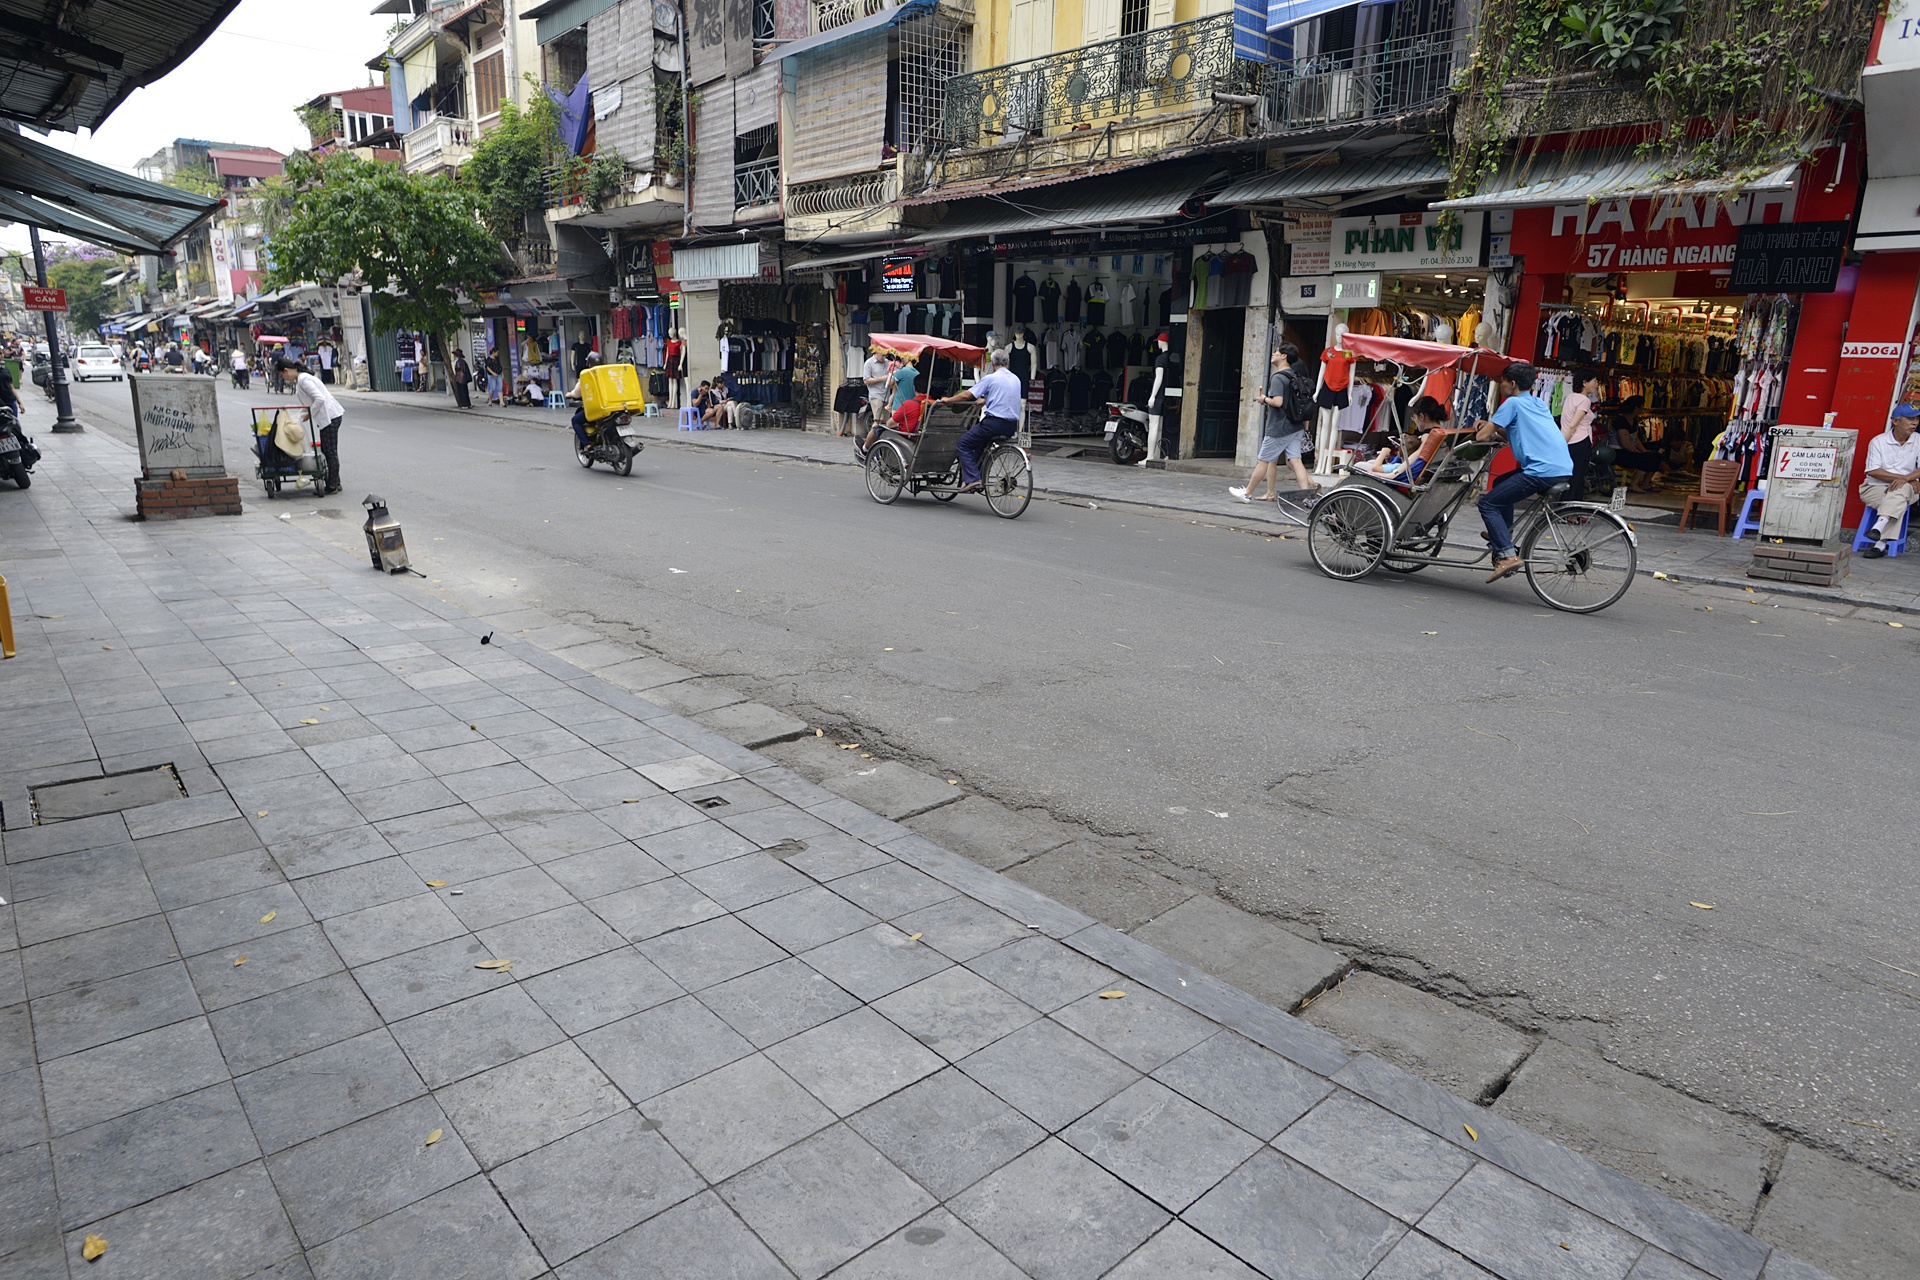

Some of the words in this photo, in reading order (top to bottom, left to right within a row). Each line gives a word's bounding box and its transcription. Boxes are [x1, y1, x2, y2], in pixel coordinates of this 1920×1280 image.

[1344, 226, 1416, 254] PHAN
[1766, 232, 1800, 248] TRANG
[1822, 230, 1840, 247] EM
[1458, 256, 1473, 264] 2330
[1587, 244, 1616, 268] 57
[1619, 247, 1668, 266] HÀNG
[1673, 244, 1736, 264] NGANG
[1342, 259, 1356, 269] Hàng
[1358, 260, 1376, 269] Ngang
[1735, 252, 1768, 284] HÀ
[1775, 256, 1834, 284] ANH
[1715, 278, 1730, 288] 57
[1304, 287, 1312, 296] 55
[1335, 283, 1361, 298] PHAN
[1364, 279, 1376, 298] VŨ
[35, 295, 56, 303] CẤM
[1843, 346, 1898, 356] SADOGA
